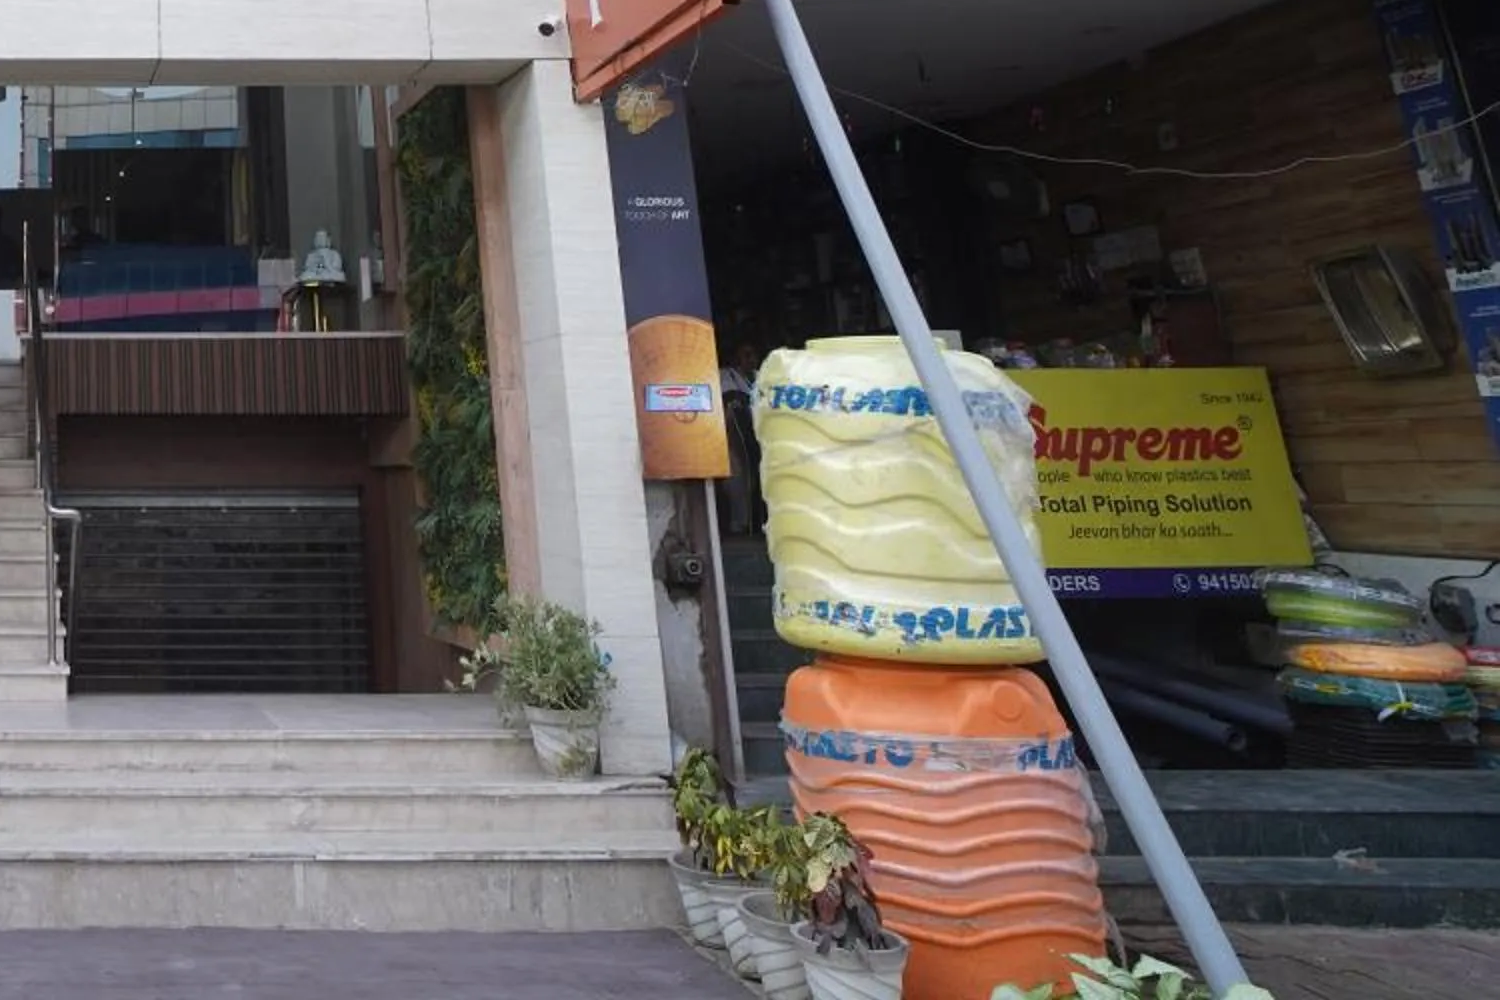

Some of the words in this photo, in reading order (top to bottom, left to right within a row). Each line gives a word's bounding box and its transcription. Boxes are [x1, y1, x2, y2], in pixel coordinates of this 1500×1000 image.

[1029, 403, 1244, 478] Supreme
[1037, 469, 1070, 484] ople
[1093, 469, 1123, 481] who
[1125, 468, 1163, 481] know
[1166, 468, 1218, 484] plastics
[1221, 468, 1253, 481] best
[1040, 494, 1087, 514] Total
[1092, 494, 1160, 517] Piping
[1165, 494, 1253, 513] Solution
[1068, 524, 1120, 540] Jeevan
[1121, 522, 1156, 539] bhar
[1159, 522, 1178, 538] ka
[1050, 574, 1101, 592] DERS
[922, 603, 1033, 641] PLAS
